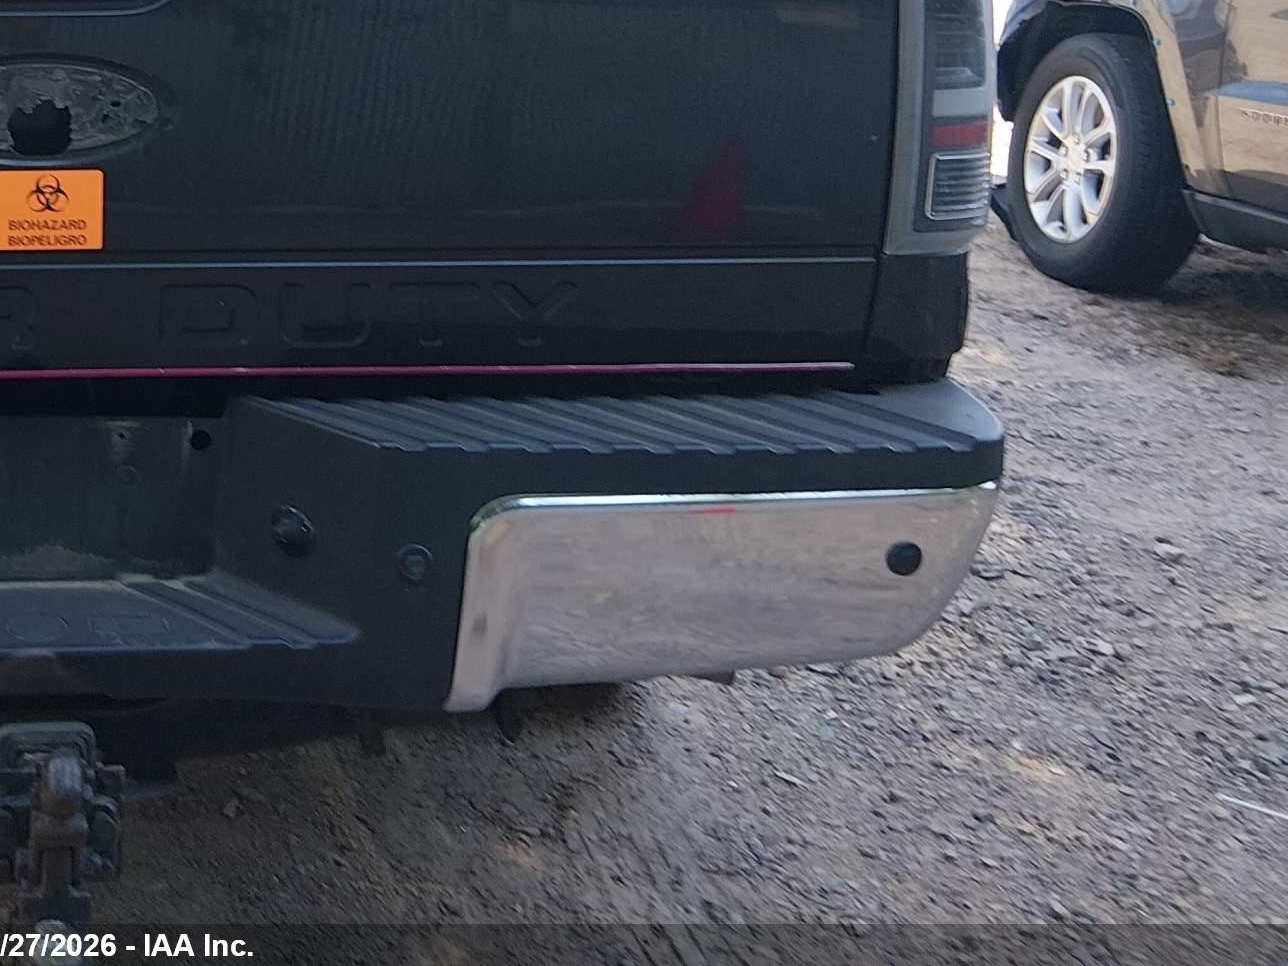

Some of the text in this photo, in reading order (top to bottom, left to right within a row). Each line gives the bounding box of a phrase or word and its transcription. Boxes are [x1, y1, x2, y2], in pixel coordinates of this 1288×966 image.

[8, 219, 87, 231] BIOHAZARD
[8, 234, 87, 247] BIOPELIGRO
[158, 280, 580, 349] DUTY
